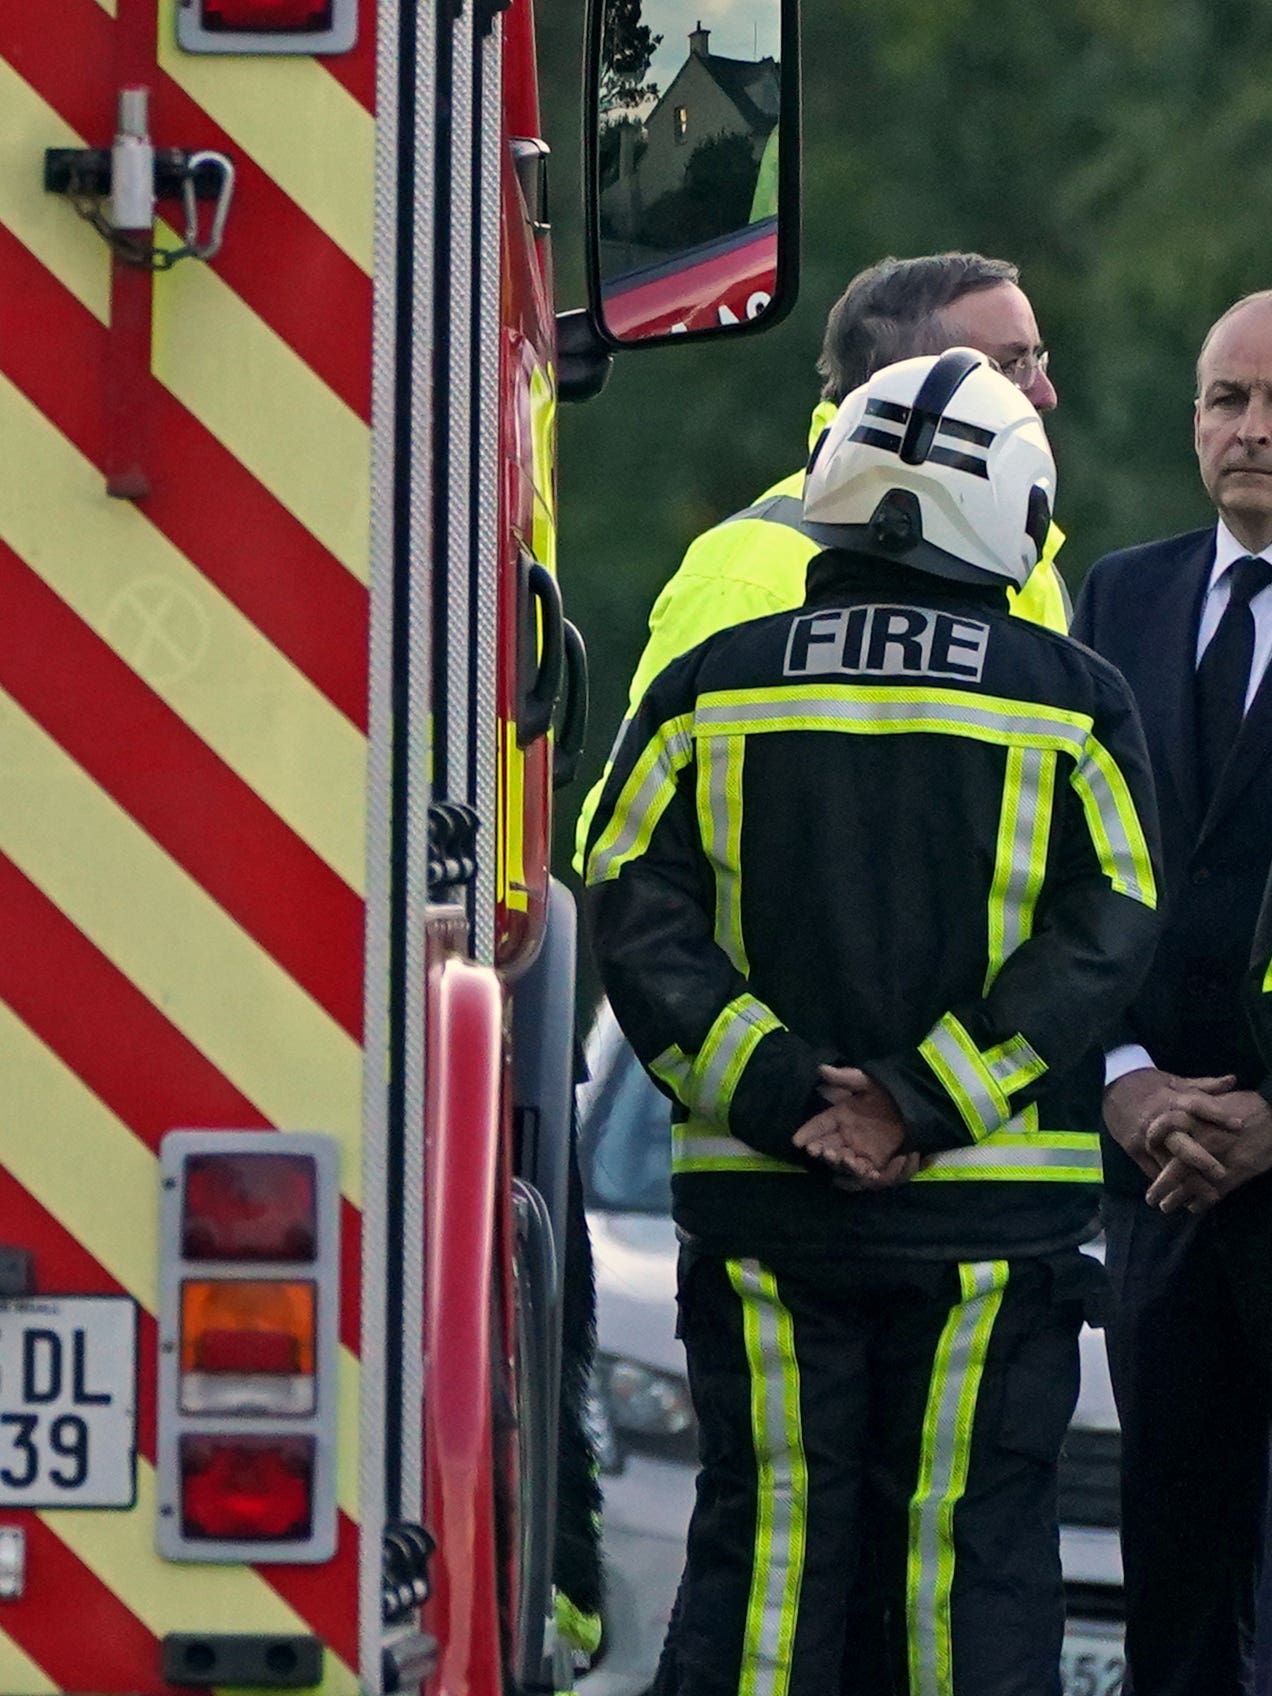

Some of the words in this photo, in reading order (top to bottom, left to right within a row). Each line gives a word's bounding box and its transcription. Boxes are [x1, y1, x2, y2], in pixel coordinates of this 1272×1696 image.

[786, 606, 985, 678] FIRE
[23, 1328, 112, 1405] DL
[0, 1413, 89, 1489] 39
